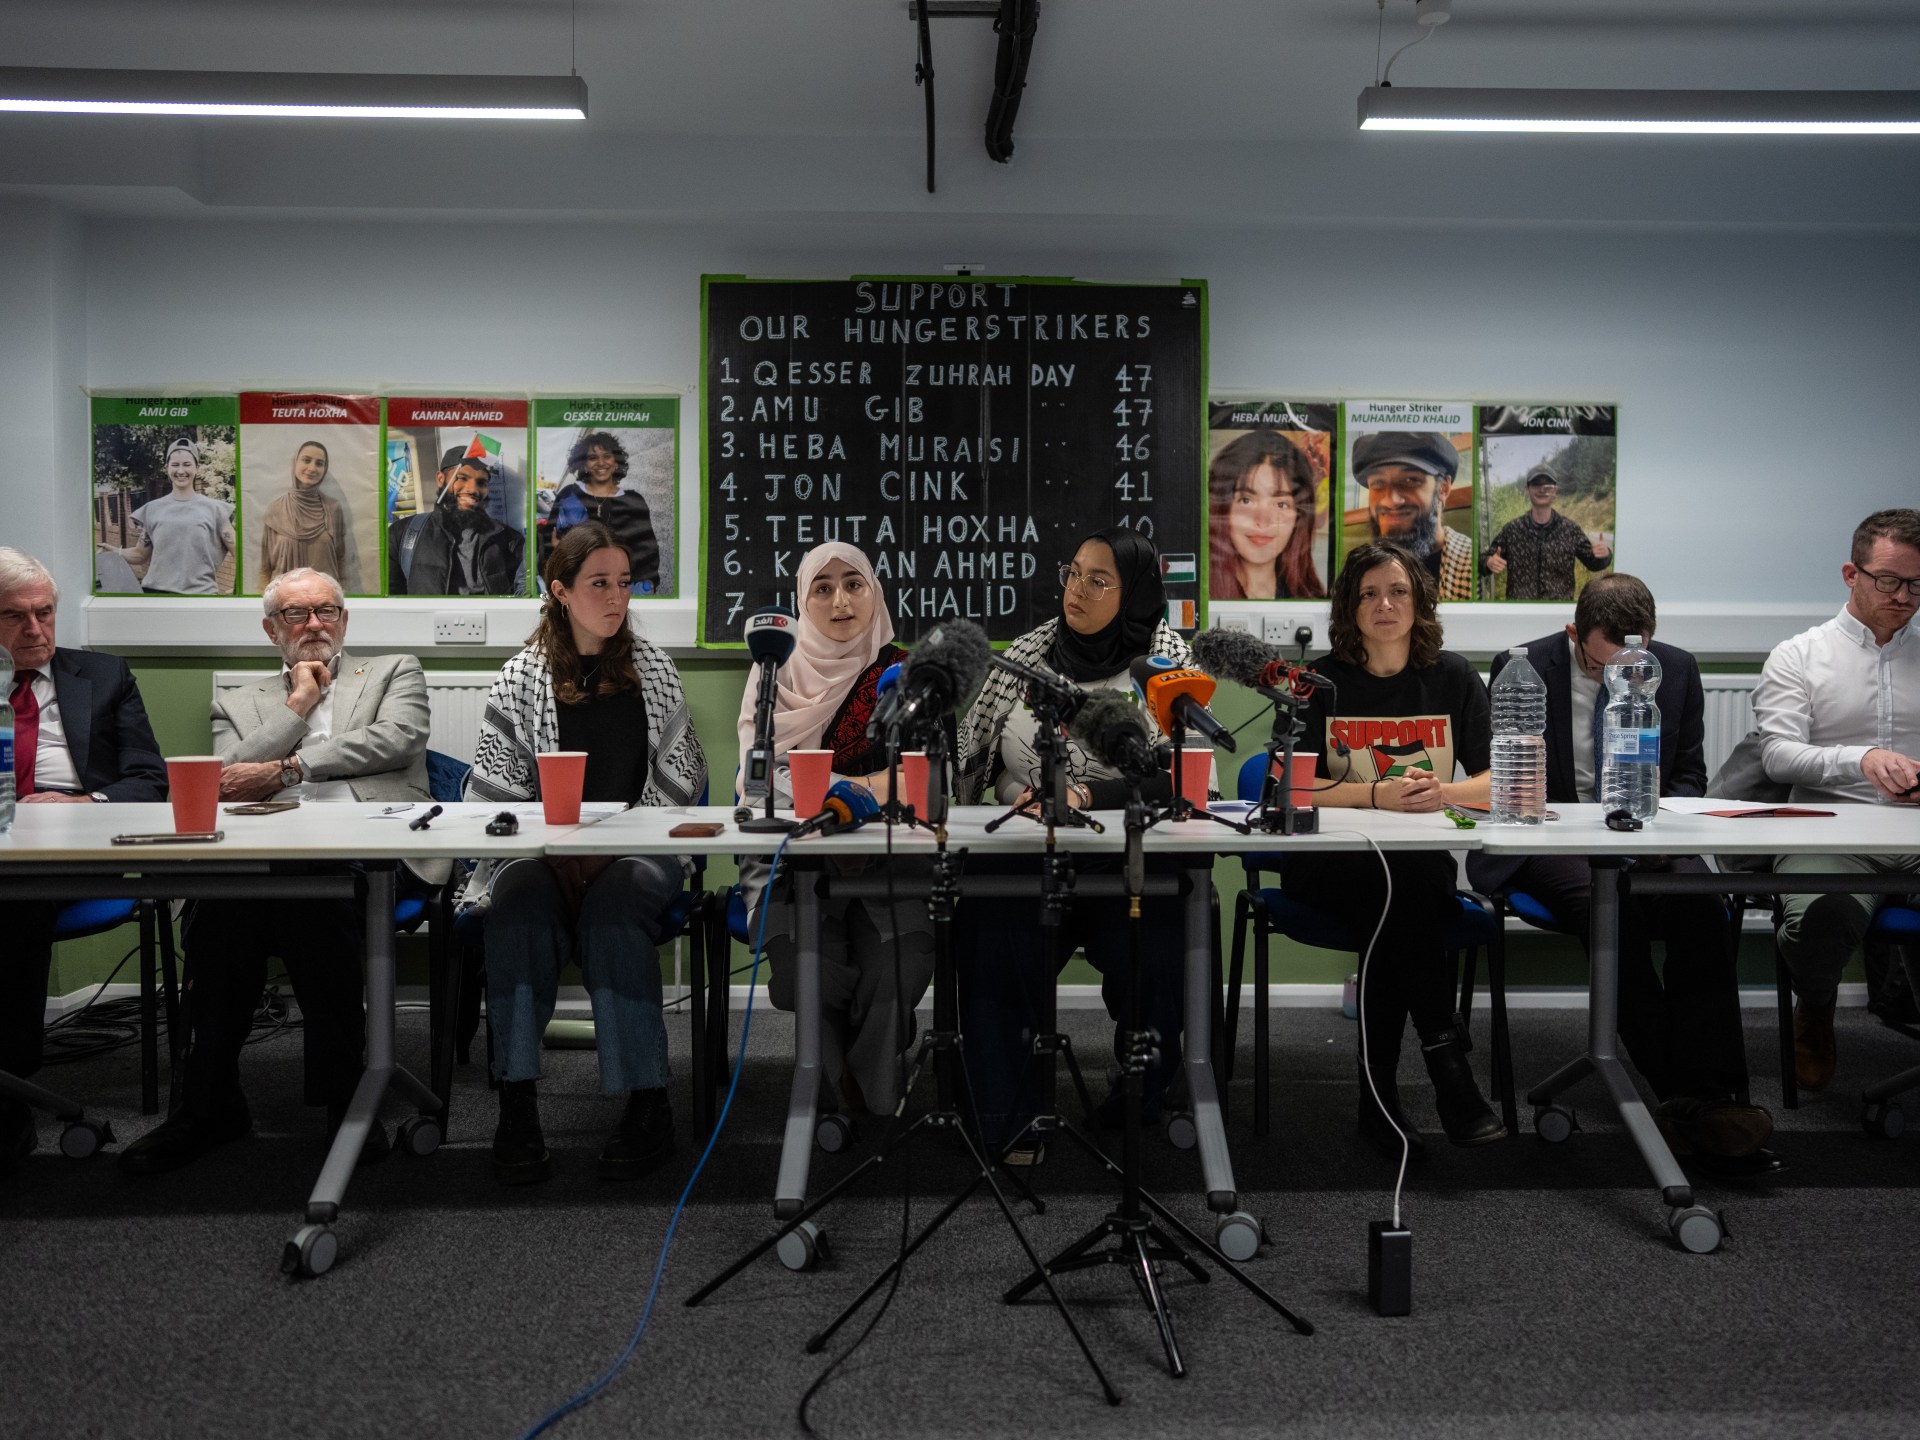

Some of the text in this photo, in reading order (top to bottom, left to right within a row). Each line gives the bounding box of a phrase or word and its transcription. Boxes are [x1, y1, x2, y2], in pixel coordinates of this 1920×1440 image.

[856, 282, 1016, 313] SUPPORT
[740, 314, 1150, 344] OUR HUNGERSTRIKERS
[720, 357, 1152, 392] 1. QESSER ZUHRAH DAY 47
[126, 397, 202, 407] Hunger Striker
[419, 399, 457, 411] Hunger
[138, 407, 189, 417] AMU GIB
[271, 408, 348, 418] TEUTA HOXHA
[720, 395, 1152, 426] 2. AMU GIB 47
[1369, 403, 1442, 414] Hunger Striker
[411, 411, 504, 421] KAMRAN AHMED
[563, 411, 650, 423] QESSER ZUHRAH
[1231, 412, 1260, 422] HEBA
[1351, 414, 1461, 424] MUHAMMED KHALID
[1523, 418, 1571, 428] JON CINK
[721, 432, 1151, 463] 3. HEBA MURAISI 46
[720, 471, 1153, 502] 4. JON CINK 41
[725, 514, 751, 541] 5.
[766, 515, 896, 543] TEUTA
[923, 515, 1040, 543] HOXHA
[723, 549, 753, 576] 6.
[933, 550, 1036, 579] AHMED
[1330, 719, 1447, 750] SUPPORT
[1621, 732, 1638, 740] Spring
